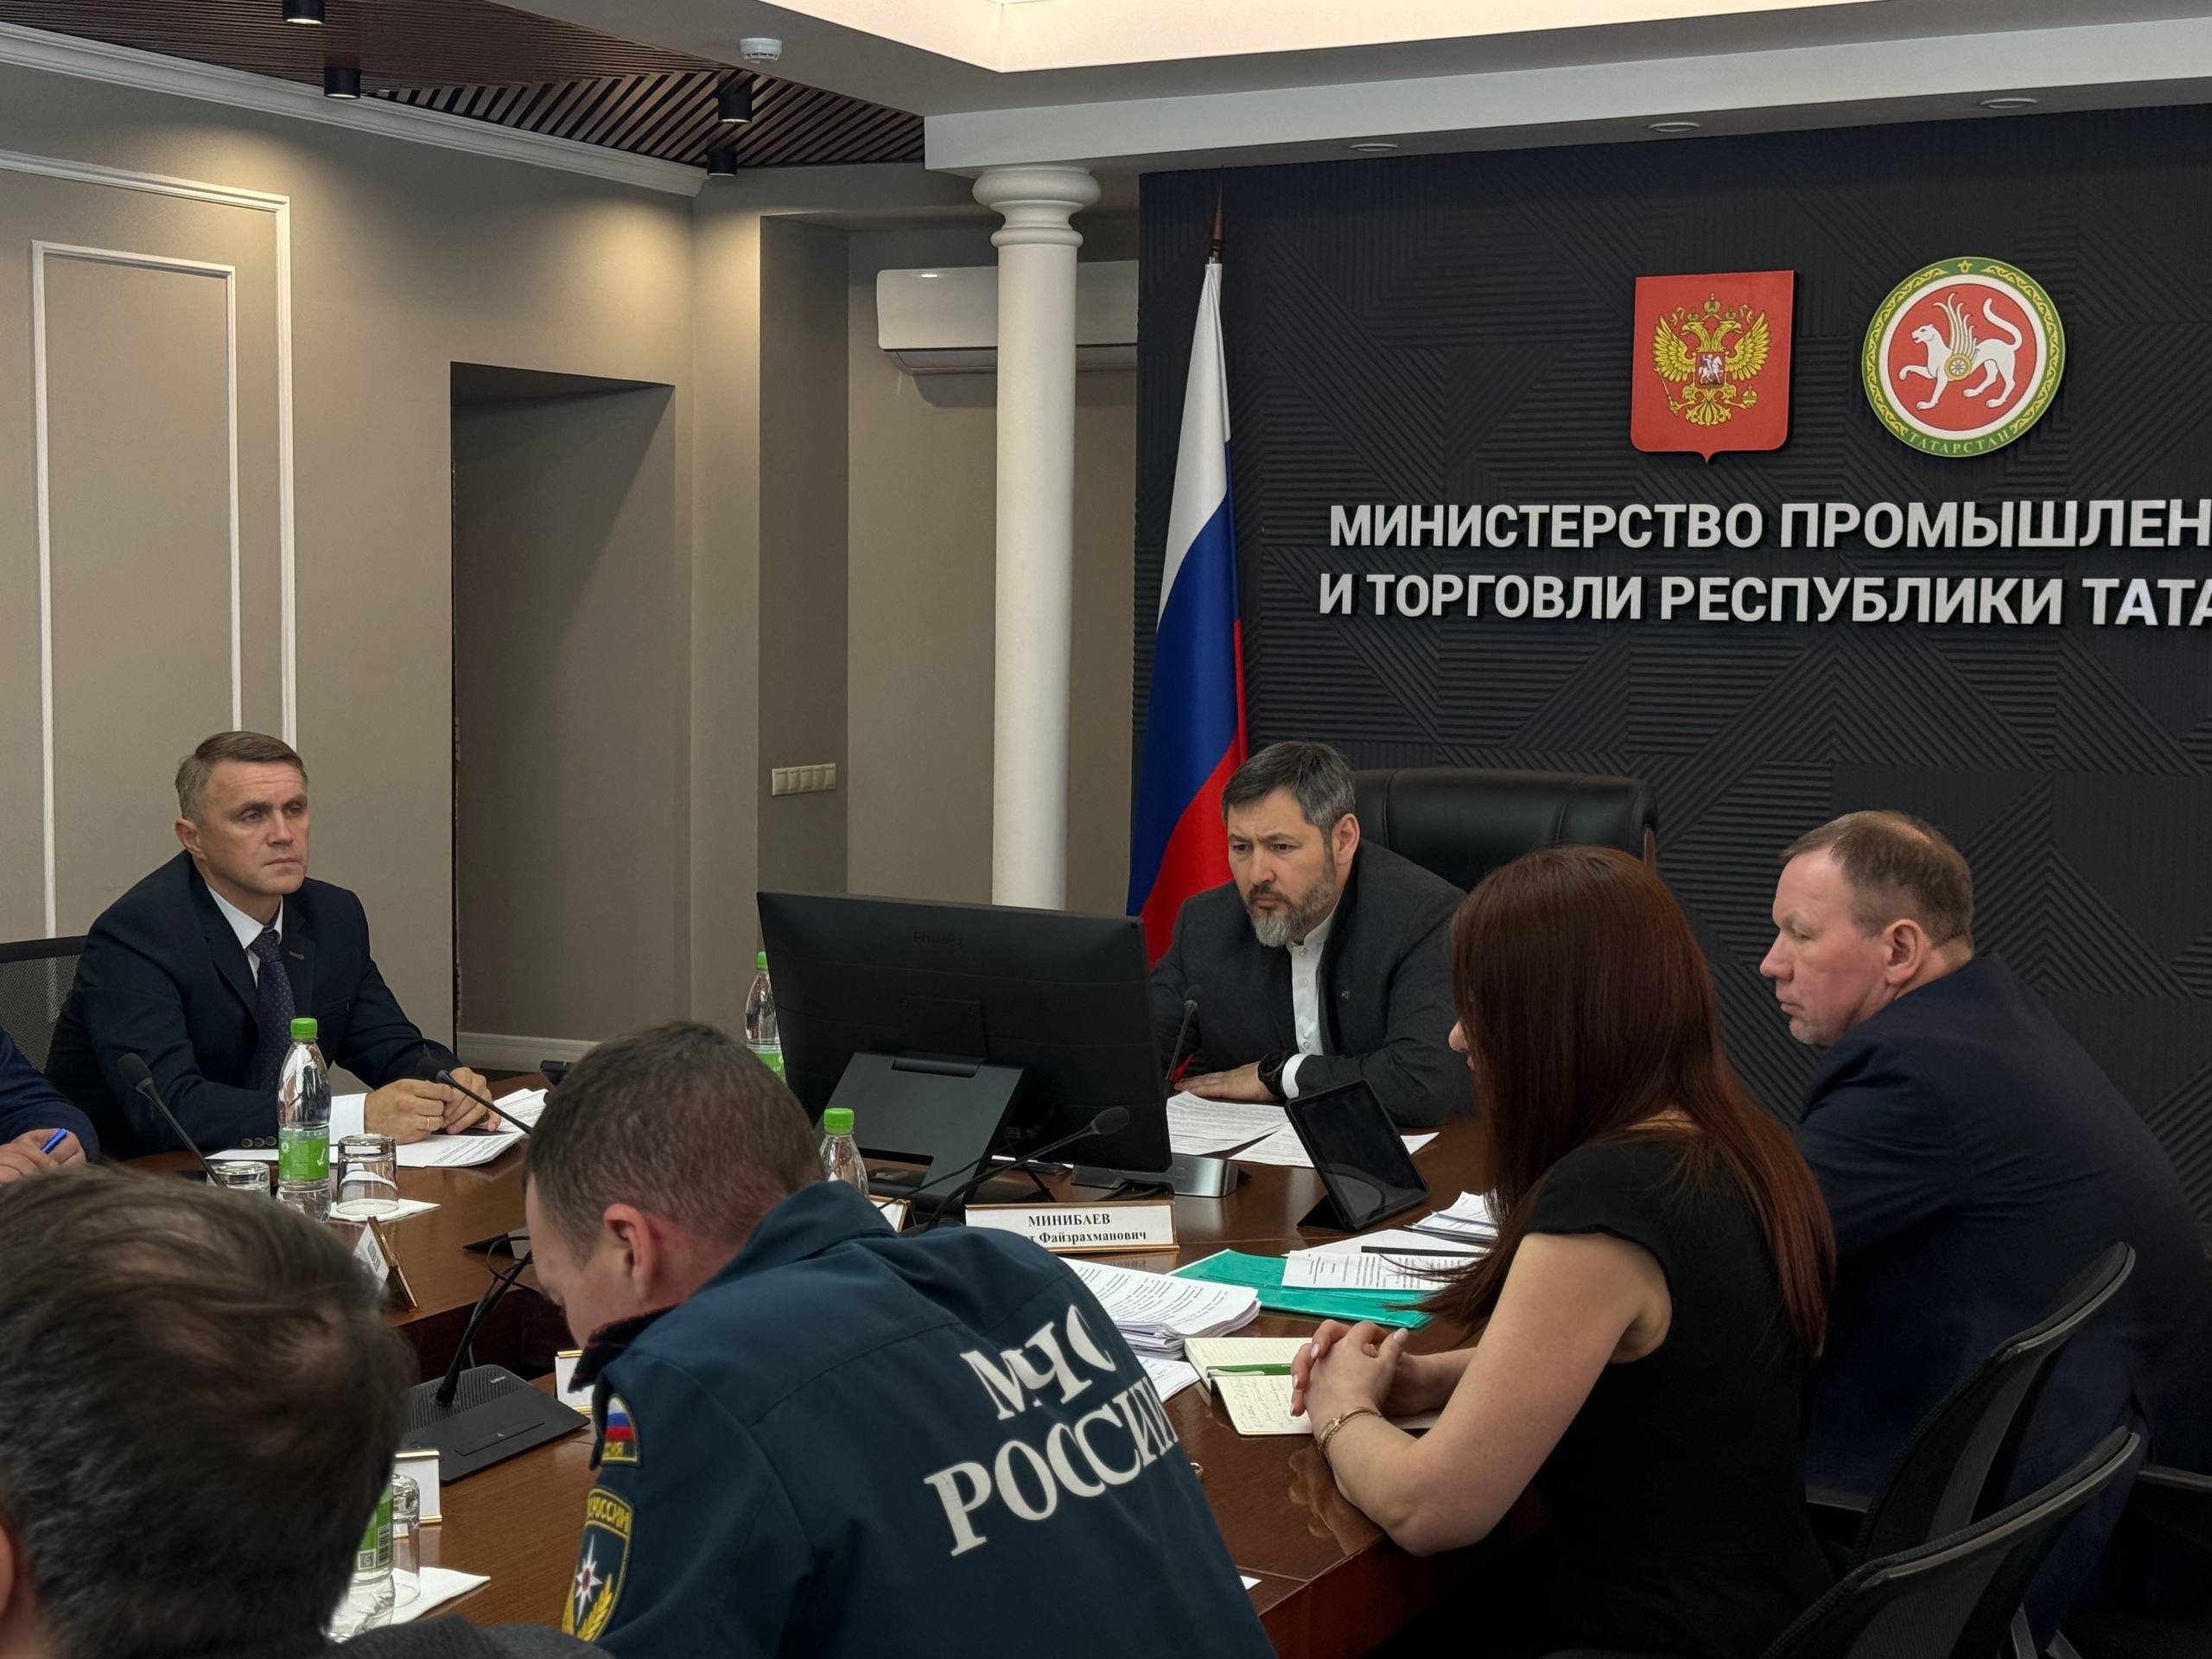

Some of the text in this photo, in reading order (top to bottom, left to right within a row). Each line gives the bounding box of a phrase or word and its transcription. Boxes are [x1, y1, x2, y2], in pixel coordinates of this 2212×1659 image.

[1910, 430, 2012, 454] ТАТАРСТАН
[1330, 499, 2212, 549] МИНИСТЕРСТВО ПРОМЫШЛЕН
[1319, 573, 1352, 614] И
[1366, 574, 1642, 620] ТОРГОВЛИ
[1661, 576, 2063, 625] РЕСПУБЛИКИ
[1028, 1213, 1110, 1227] МИНИБАЕВ
[1039, 1231, 1147, 1245] Файзрахманович
[959, 1305, 1117, 1421] МЧС
[923, 1376, 1179, 1557] РОССИИ
